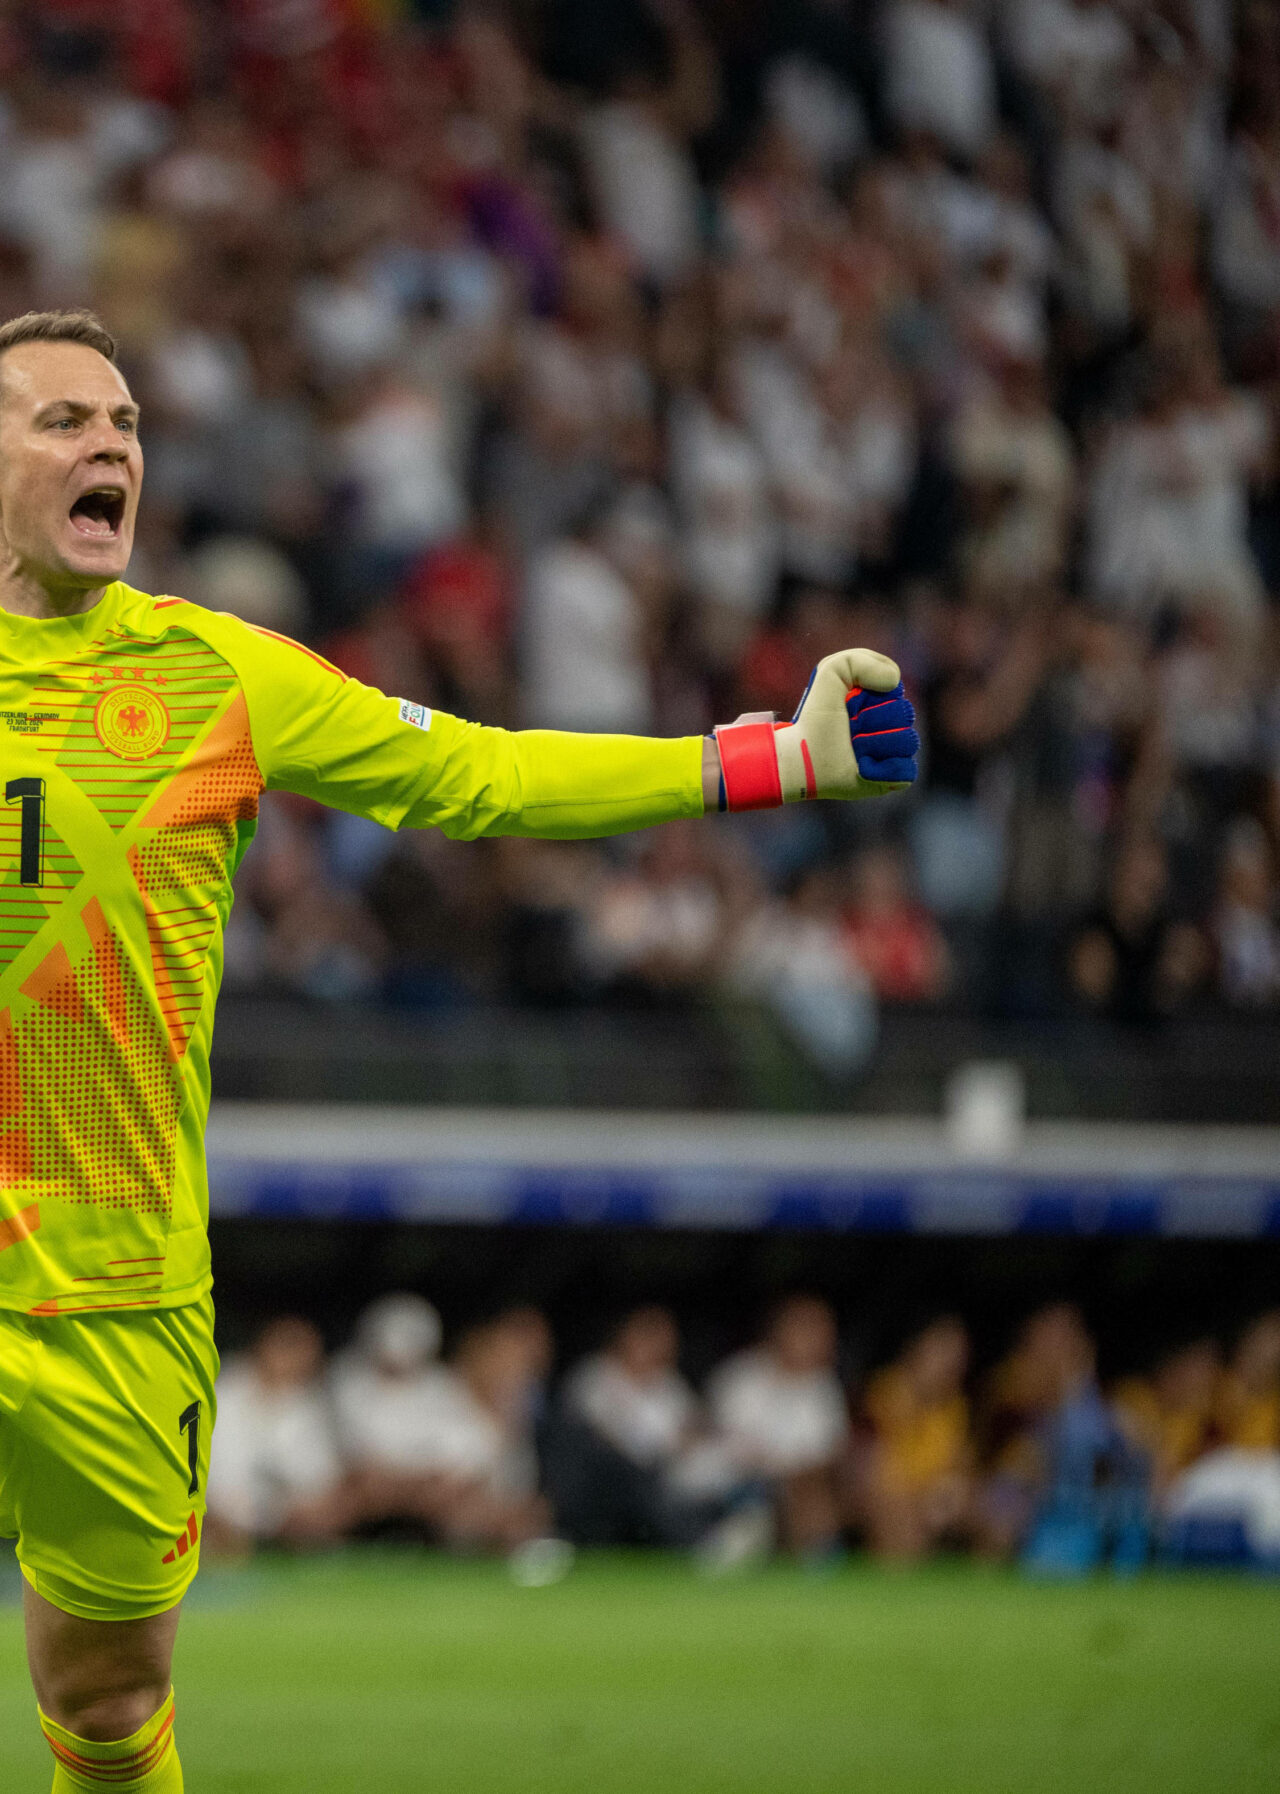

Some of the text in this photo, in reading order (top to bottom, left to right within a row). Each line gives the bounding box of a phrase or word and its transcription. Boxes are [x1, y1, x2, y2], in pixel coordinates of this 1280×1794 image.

[15, 718, 28, 726] JUNE
[29, 719, 44, 727] 2024
[109, 693, 153, 707] DEUTSCHER
[5, 777, 46, 888] 1
[179, 1400, 202, 1499] 1
